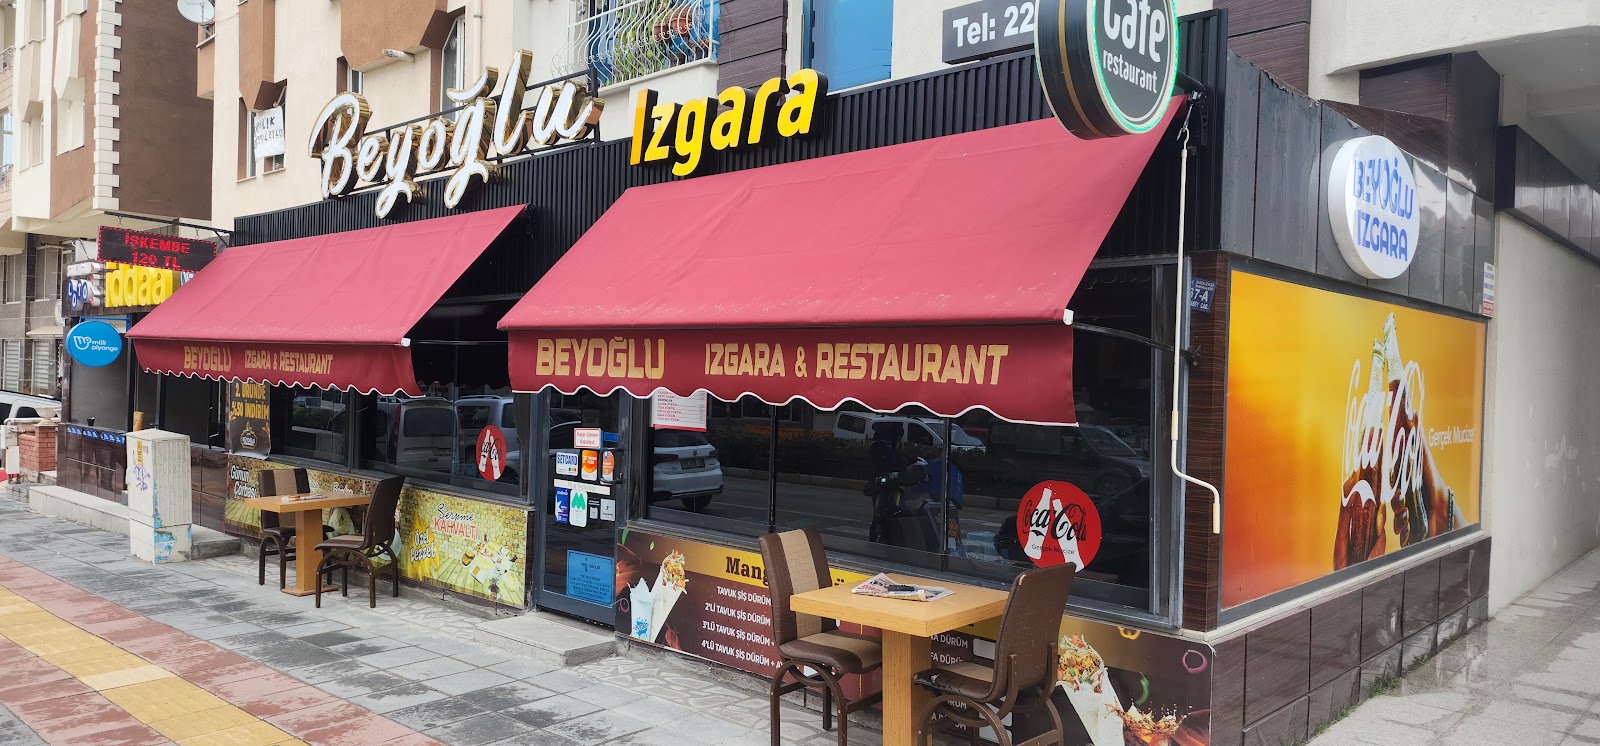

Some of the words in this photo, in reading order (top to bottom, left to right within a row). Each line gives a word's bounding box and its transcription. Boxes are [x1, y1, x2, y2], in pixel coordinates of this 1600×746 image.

[952, 13, 996, 47] Tel:
[1103, 0, 1166, 63] Cafe
[1102, 49, 1158, 94] restaurant
[308, 49, 603, 219] Beyoğlu
[629, 68, 824, 177] Izgara
[1353, 156, 1414, 220] BEYOĞLU
[124, 232, 190, 255] İŞKEMBE
[1357, 209, 1408, 262] IZGARA
[132, 251, 157, 265] 120
[164, 255, 181, 269] TL
[91, 345, 118, 353] piyango
[183, 346, 231, 373] BEYOĞLU
[244, 349, 271, 370] IZGARA
[273, 354, 278, 370] &
[279, 351, 333, 375] RESTAURANT
[535, 336, 665, 380] BEYOĞLU
[704, 343, 786, 378] IZGARA
[794, 346, 808, 378] &
[816, 343, 1009, 385] RESTAURANT
[244, 399, 269, 420] İNDİRİM
[1428, 426, 1452, 450] Gerçek
[1453, 425, 1474, 444] Mucize
[557, 453, 578, 466] SETCARD
[437, 502, 474, 522] Serpme
[433, 517, 479, 540] KAHVALTI
[717, 586, 737, 599] TAVUK
[738, 588, 747, 602] ŞİŞ
[748, 591, 771, 606] DÜRÜM
[716, 606, 736, 618] TAVUK
[737, 608, 746, 621] ŞİŞ
[747, 611, 771, 626] DÜRÜM
[715, 624, 736, 637] TAVUK
[736, 627, 746, 641] ŞİŞ
[746, 630, 770, 647] DÜRÜM
[940, 634, 968, 649] DÜRÜM
[715, 643, 735, 656] TAVUK
[736, 647, 745, 660] ŞİŞ
[746, 650, 770, 667] DÜRÜM
